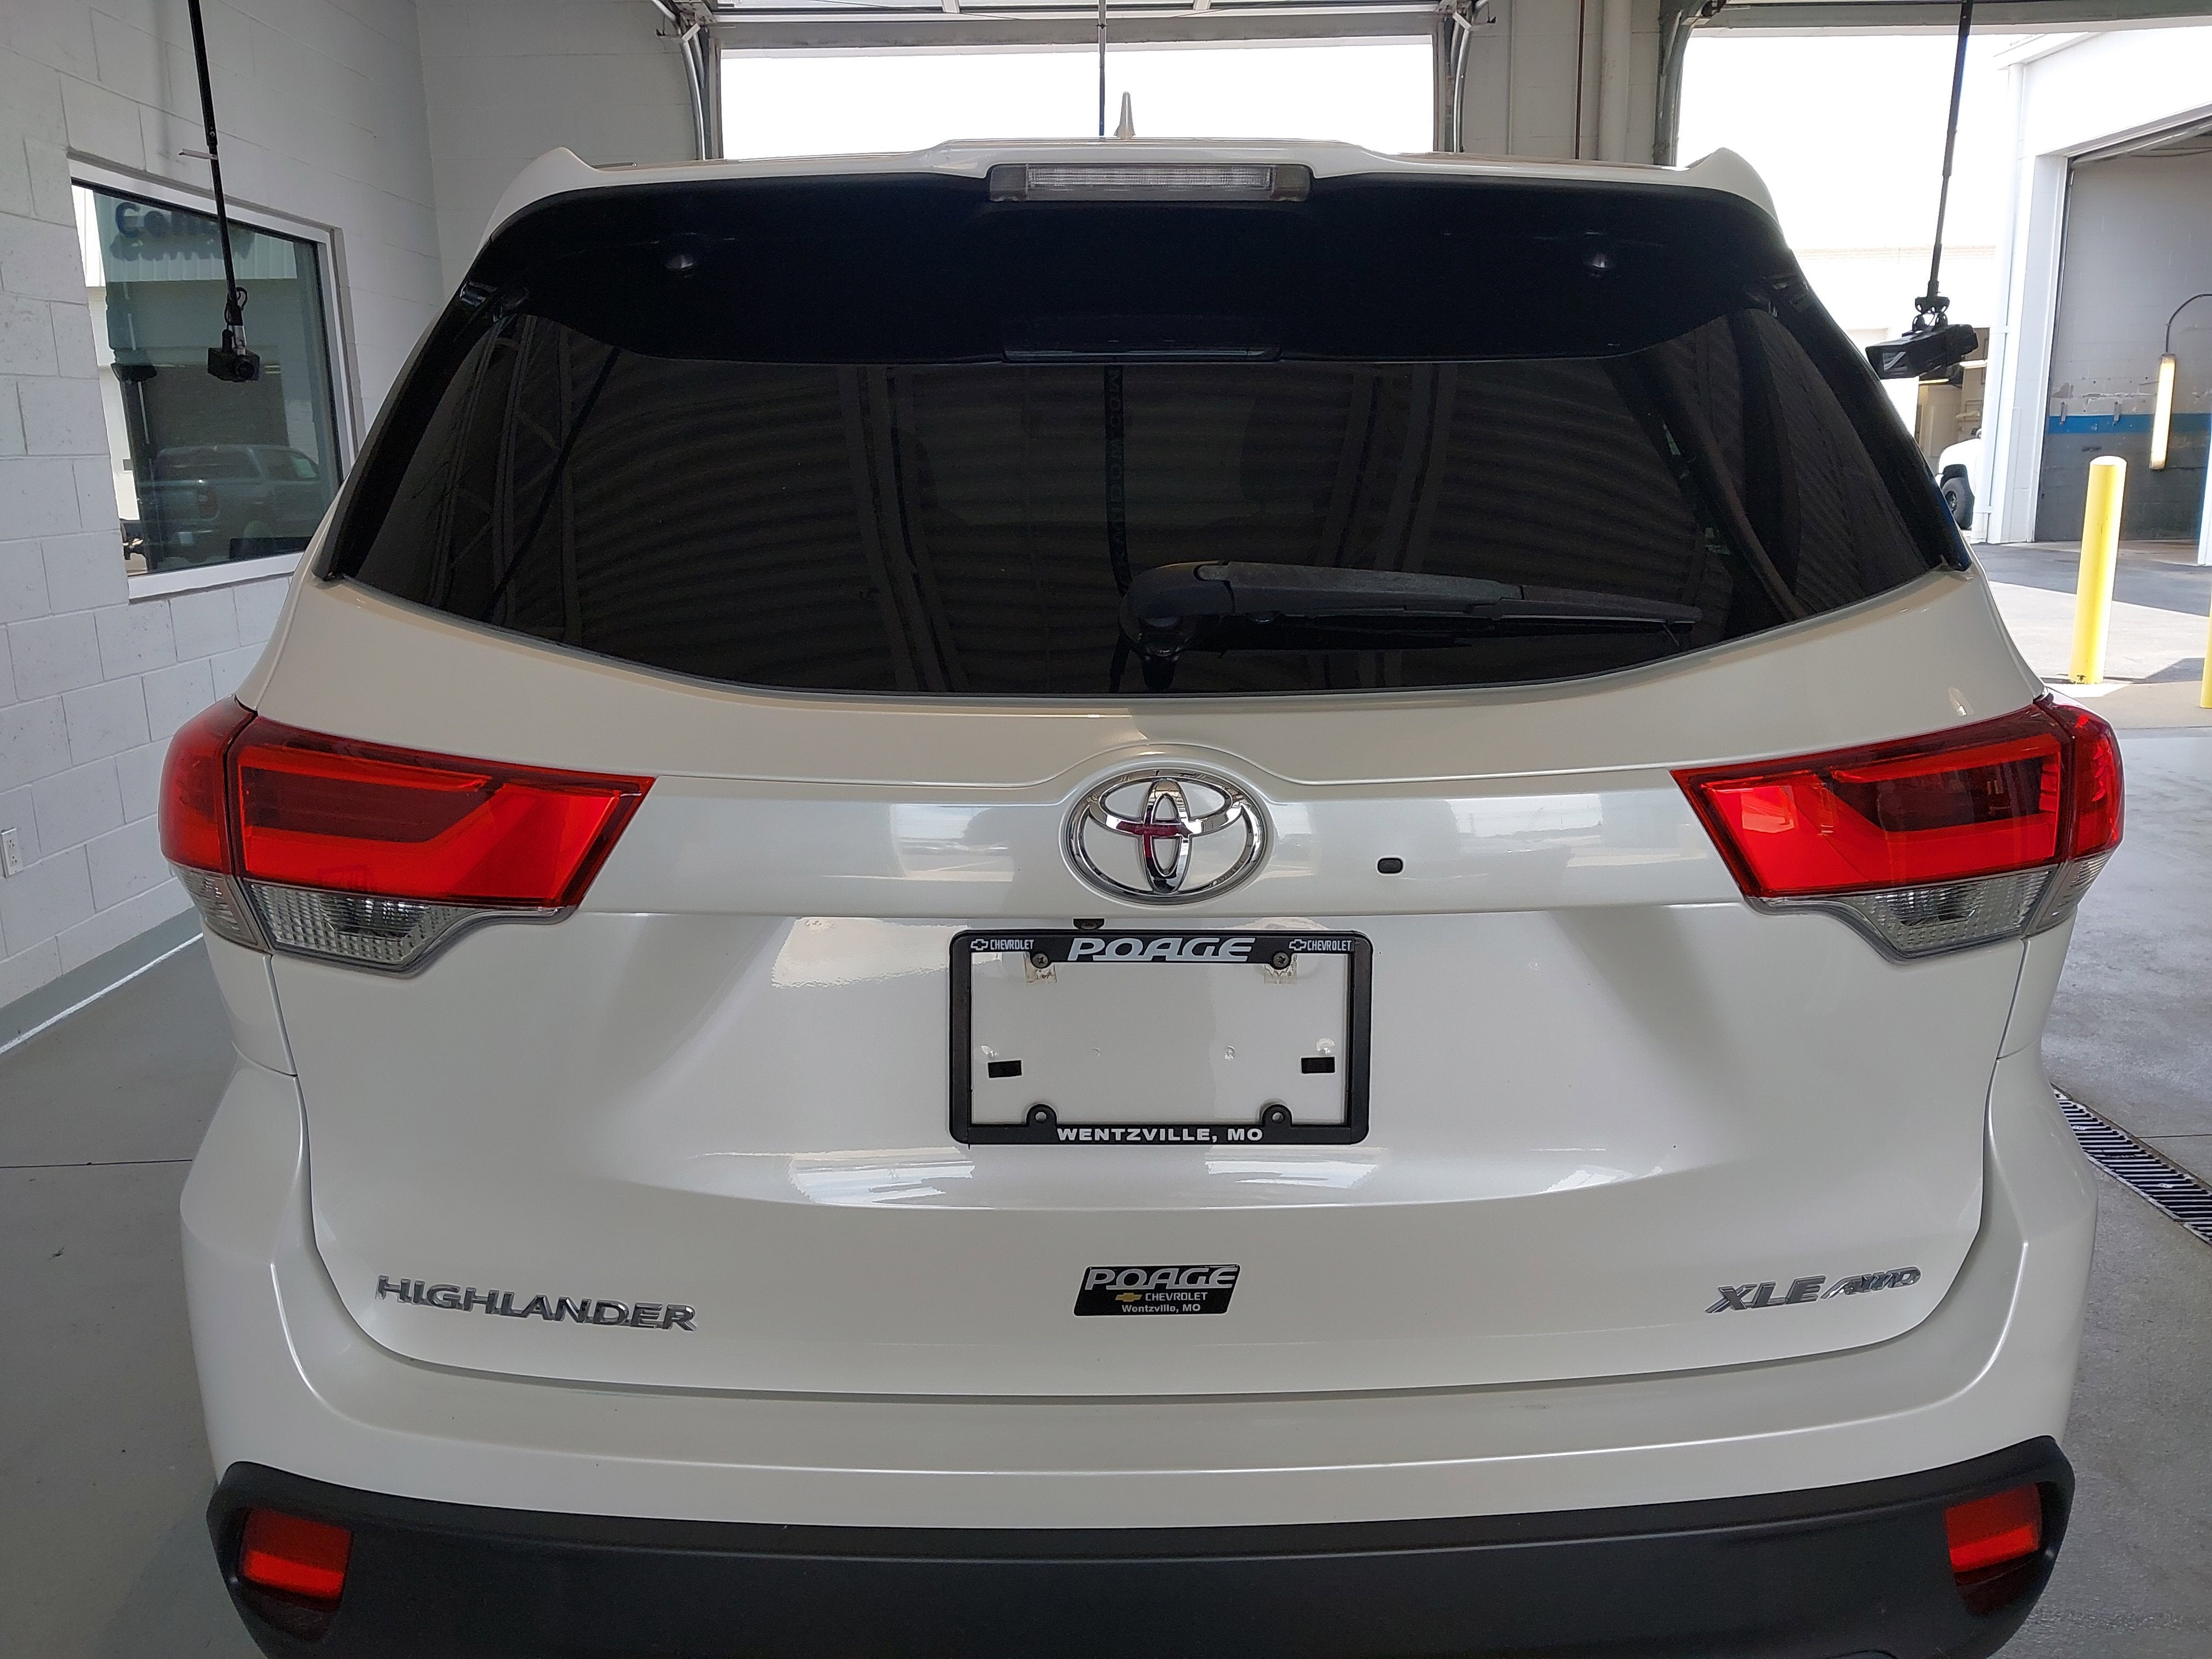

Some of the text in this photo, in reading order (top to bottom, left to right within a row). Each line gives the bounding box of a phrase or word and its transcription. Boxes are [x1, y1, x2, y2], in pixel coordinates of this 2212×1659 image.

[989, 938, 1034, 951] CHEVROLET
[1068, 937, 1256, 962] POAGE
[1307, 940, 1352, 951] CHEVROLET
[1057, 1128, 1263, 1142] WENTZVILLE, MO
[1084, 1266, 1238, 1291] POAGE
[1145, 1292, 1208, 1301] CHEVROLET
[1705, 1266, 1922, 1314] XLE AWD
[375, 1275, 698, 1332] HIGHLANDER
[1182, 1303, 1200, 1312] MO
